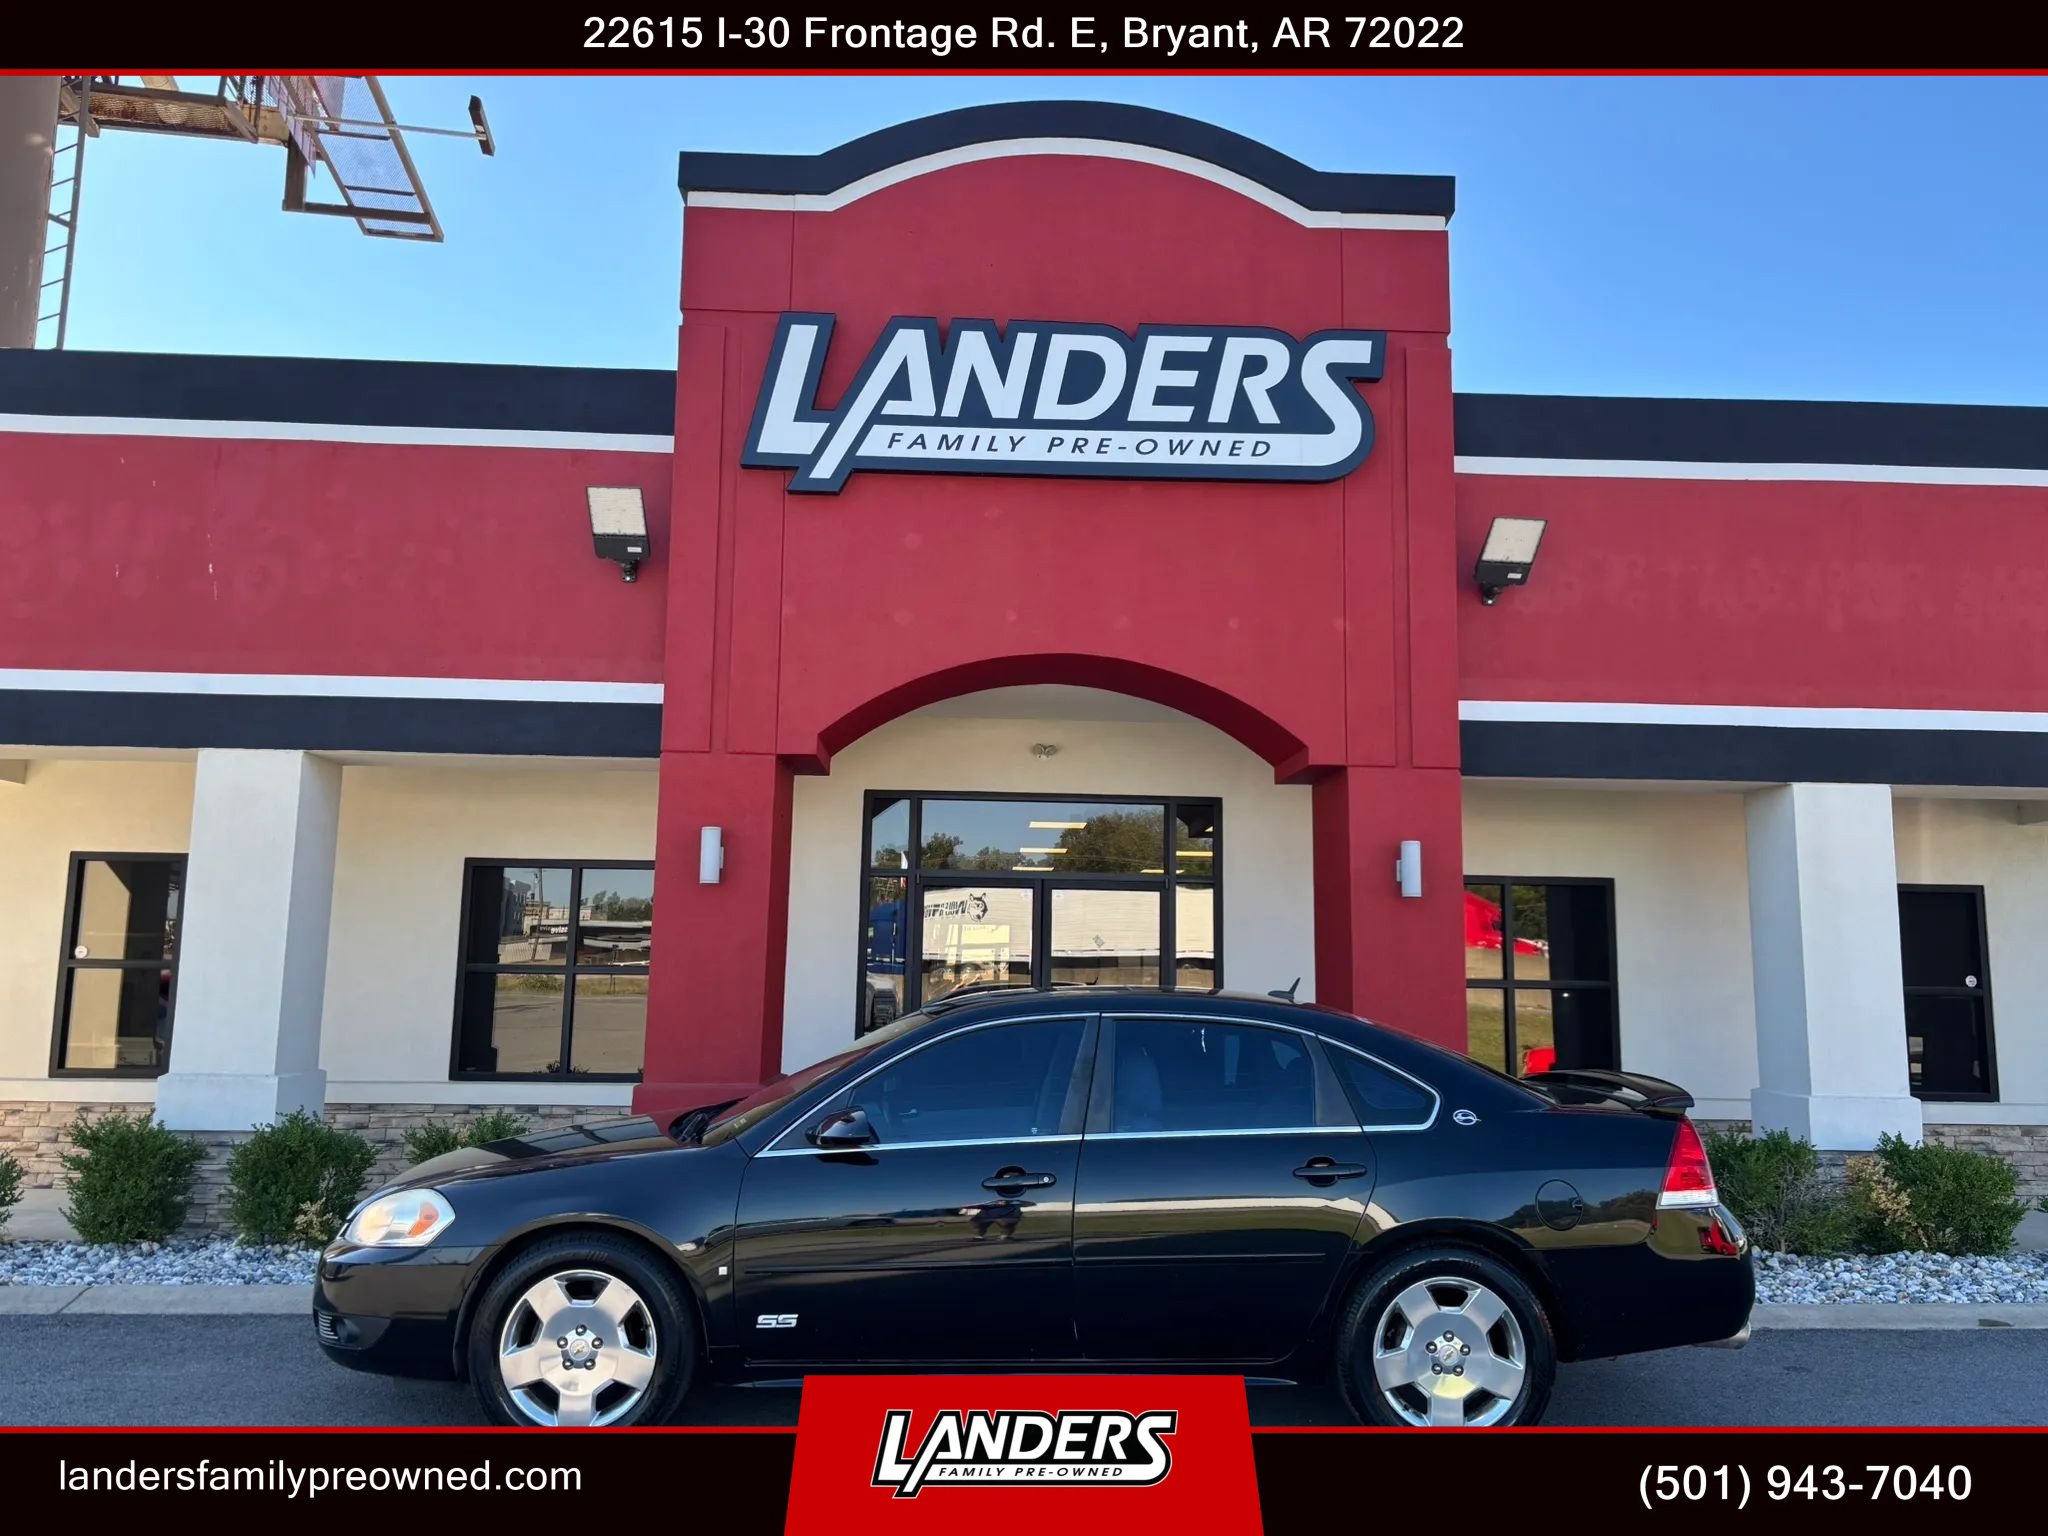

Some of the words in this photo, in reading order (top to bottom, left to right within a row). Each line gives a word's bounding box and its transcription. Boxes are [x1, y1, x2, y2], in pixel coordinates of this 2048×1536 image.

[756, 324, 1373, 479] LANDERS
[886, 432, 1027, 453] FAMILY
[1045, 436, 1273, 458] PRE-OWNED
[756, 1313, 799, 1329] SS
